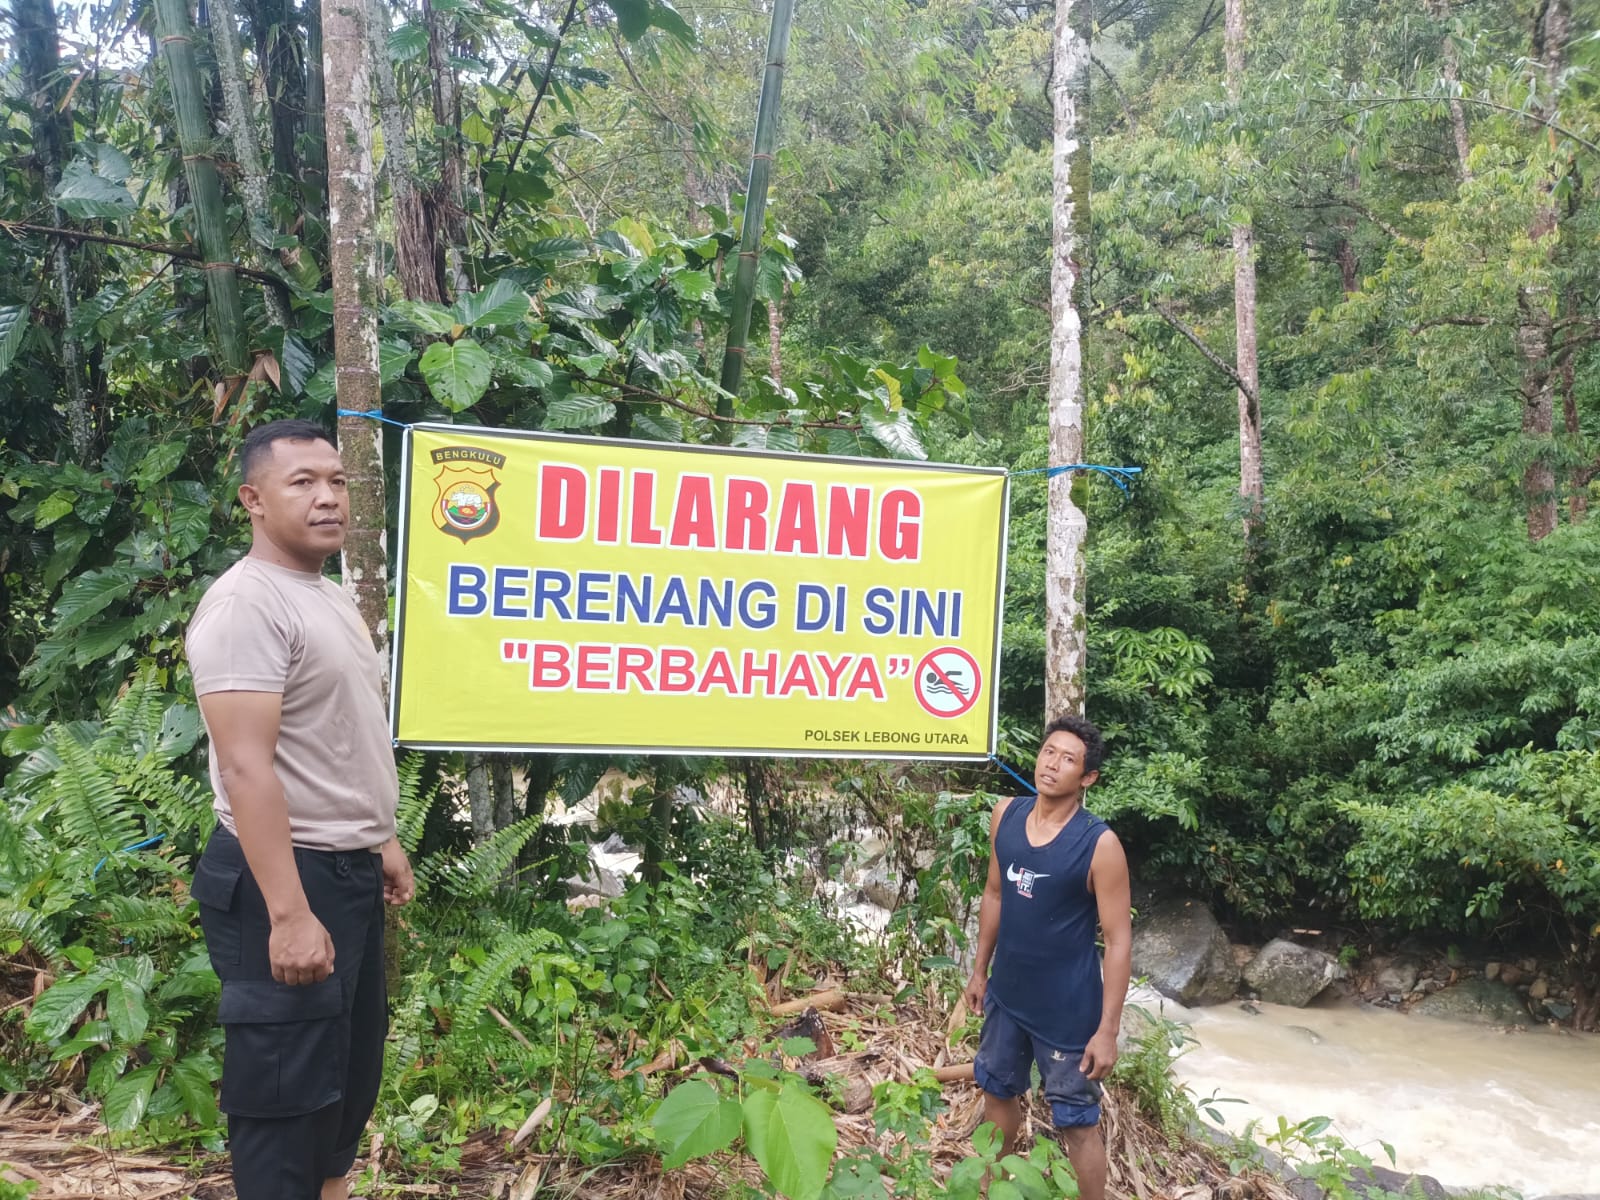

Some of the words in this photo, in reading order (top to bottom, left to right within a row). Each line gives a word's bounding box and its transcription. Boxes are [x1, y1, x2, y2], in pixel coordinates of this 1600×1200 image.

[435, 449, 501, 465] BENGKULU
[538, 464, 922, 561] DILARANG
[448, 565, 777, 629] BERENANG
[796, 584, 846, 632] DI
[863, 587, 962, 637] SINI
[804, 729, 860, 742] POLSEK
[864, 731, 921, 744] LEBONG
[924, 732, 969, 745] UTARA
